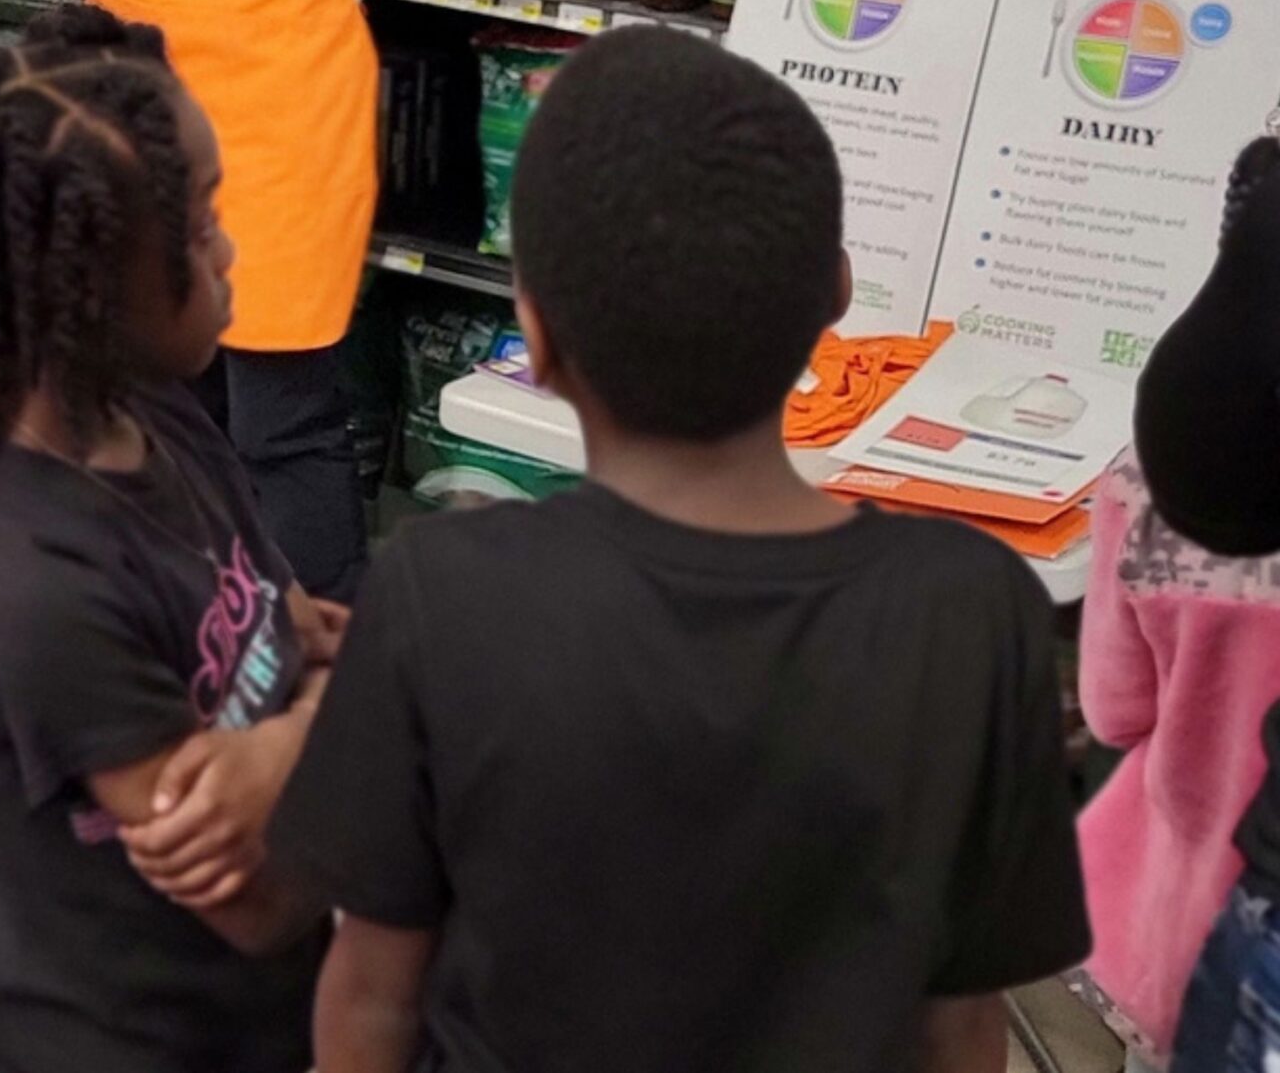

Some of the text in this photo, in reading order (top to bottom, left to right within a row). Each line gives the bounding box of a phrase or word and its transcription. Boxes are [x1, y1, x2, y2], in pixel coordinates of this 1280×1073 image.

[781, 60, 903, 95] PROTEIN
[1061, 117, 1162, 147] DAIRY
[1008, 191, 1026, 207] Try
[1098, 206, 1128, 223] dairy
[1129, 210, 1161, 226] foods
[1164, 215, 1188, 229] and
[998, 232, 1022, 247] Bulk
[1024, 237, 1054, 254] dairy
[1056, 241, 1087, 258] foods
[980, 327, 1054, 351] MATTERS
[982, 313, 1056, 337] COOKING
